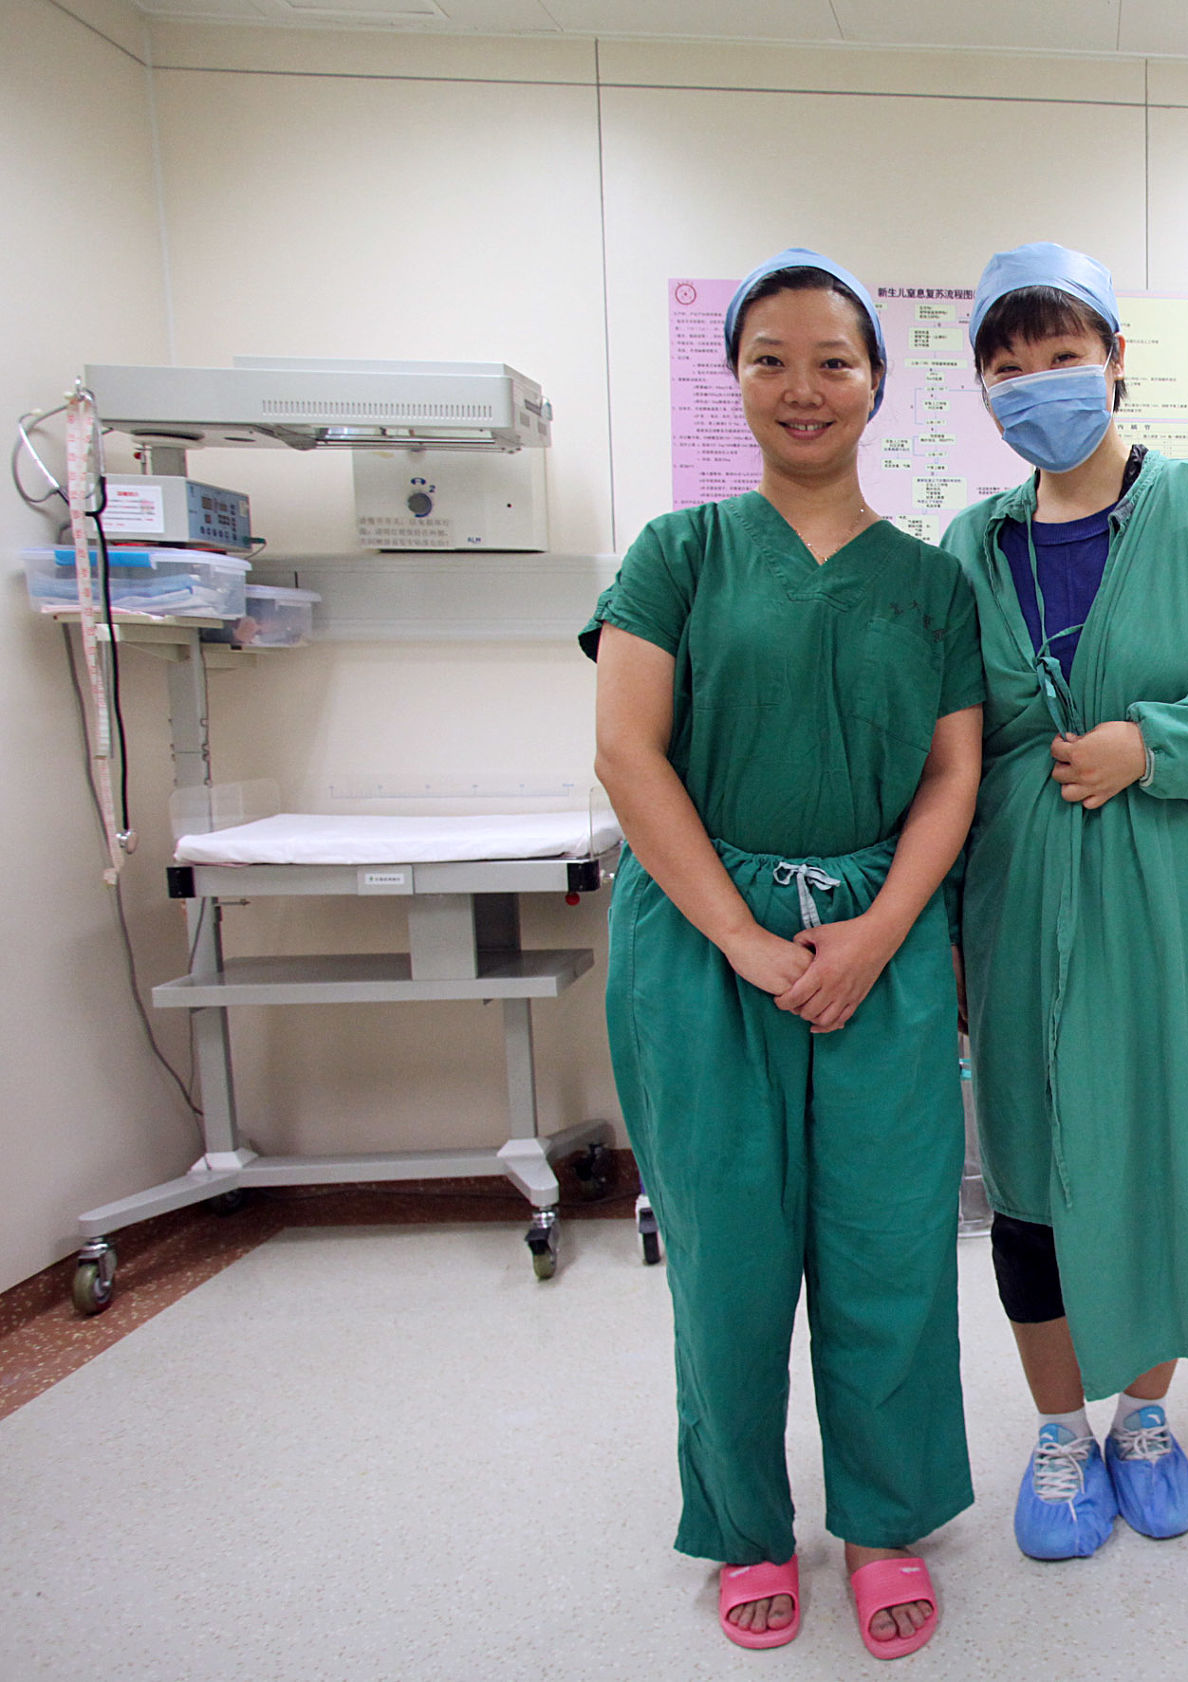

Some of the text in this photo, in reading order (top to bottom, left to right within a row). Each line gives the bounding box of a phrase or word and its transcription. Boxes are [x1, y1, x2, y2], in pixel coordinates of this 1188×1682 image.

[878, 287, 976, 300] 新生儿窒息复苏流程图
[428, 484, 436, 493] 2
